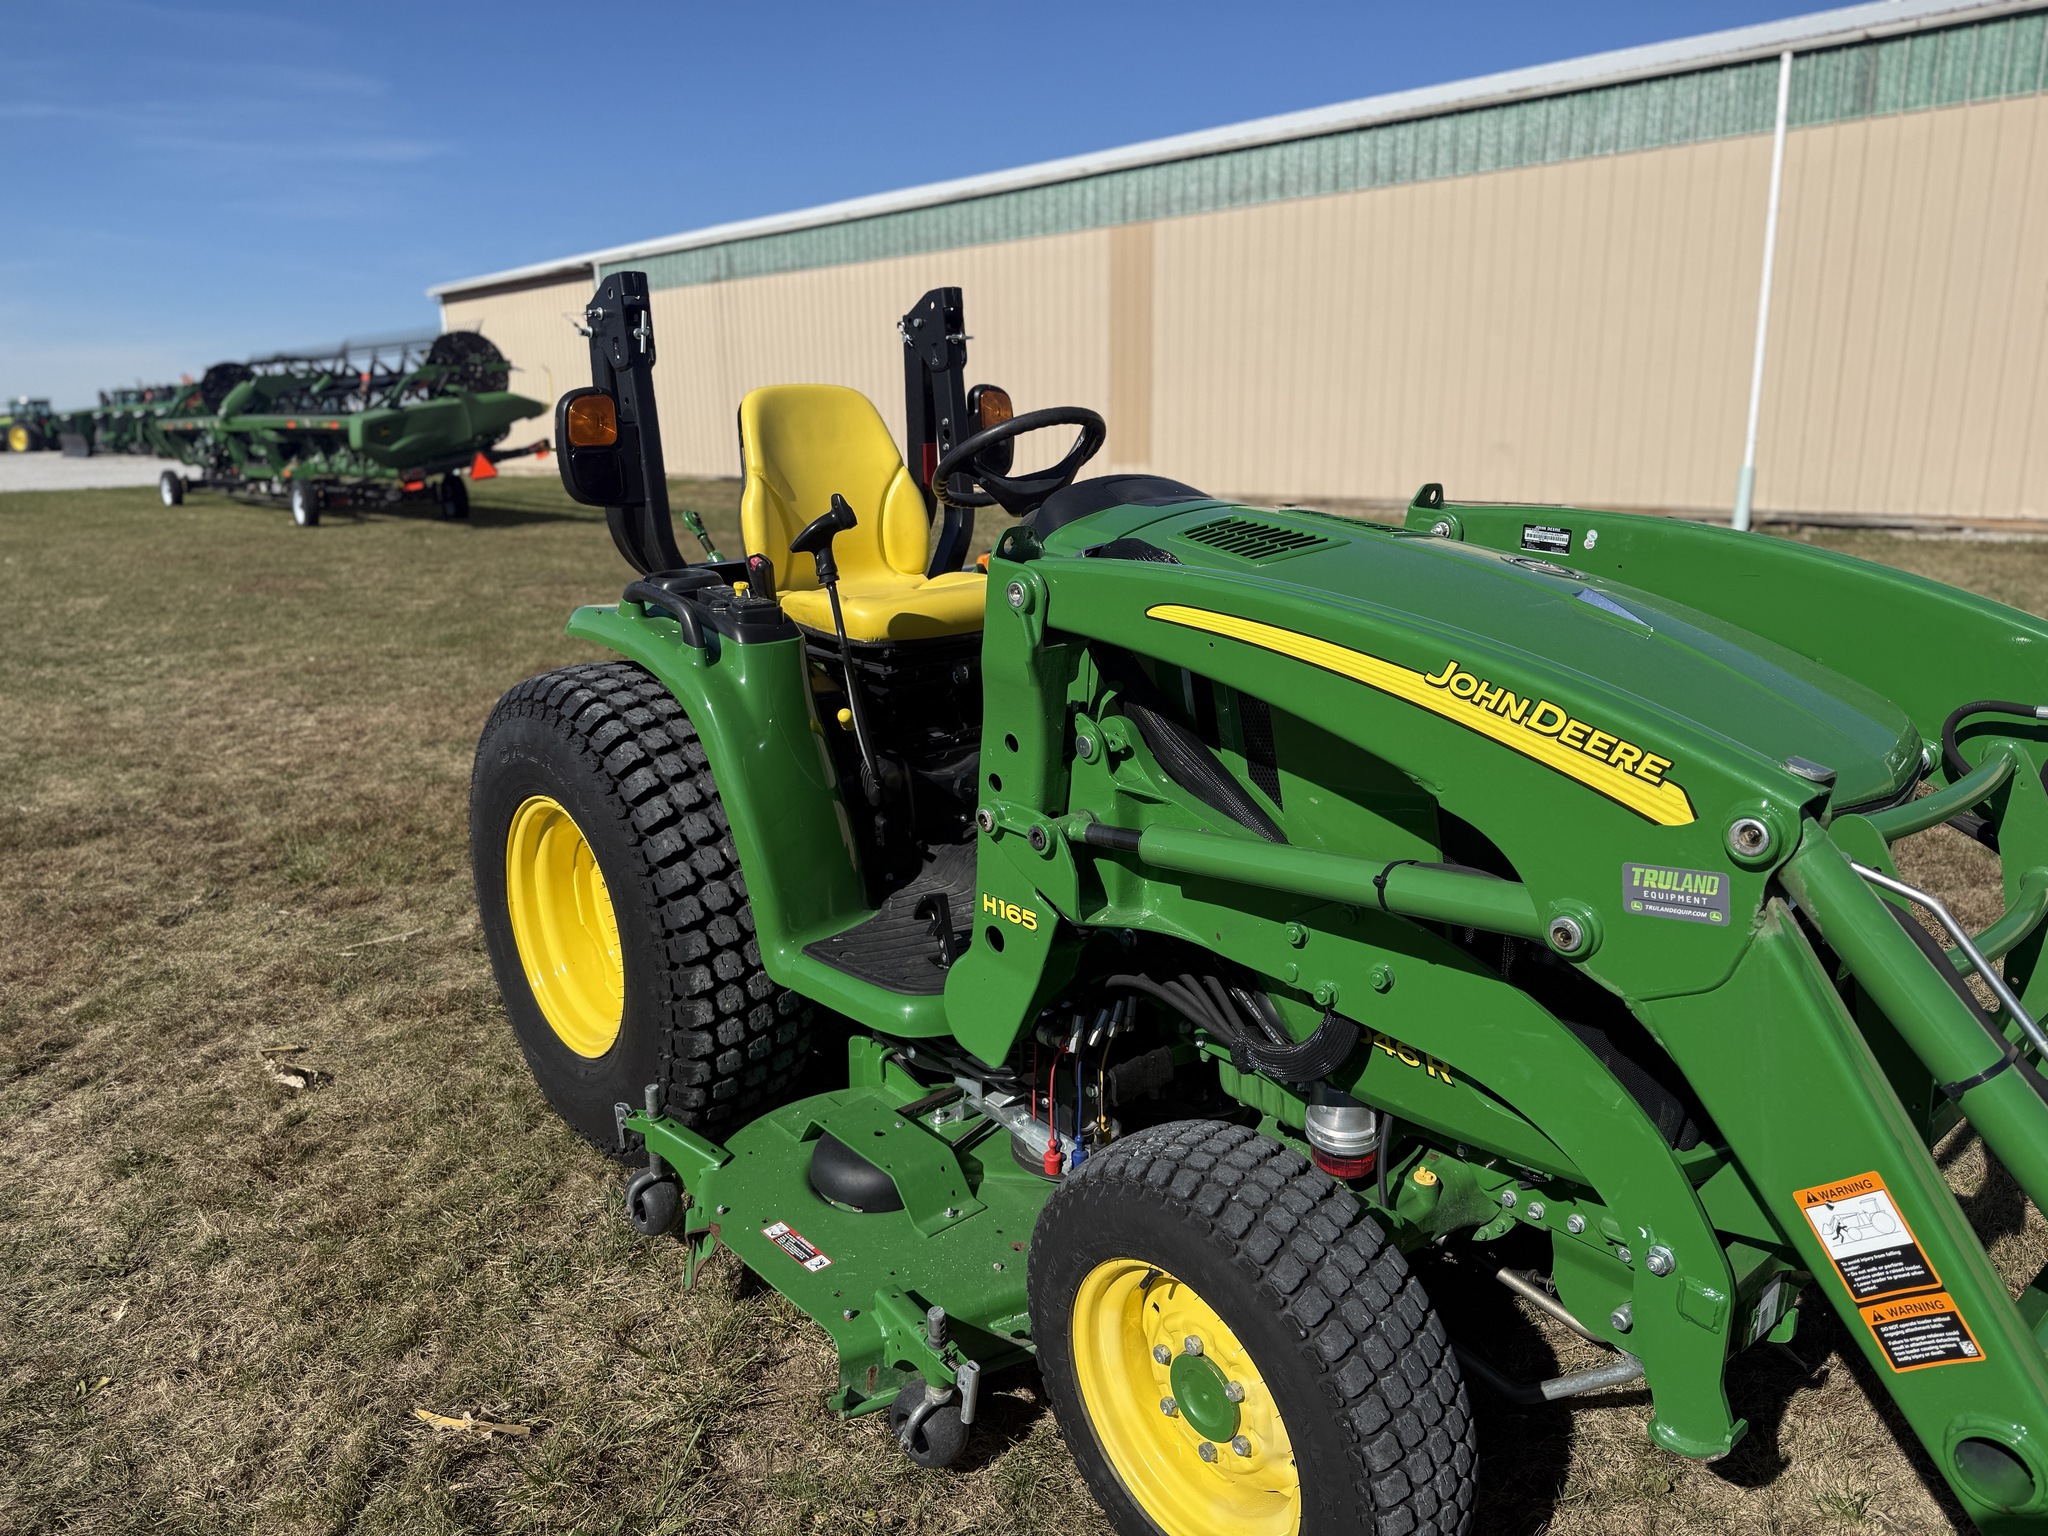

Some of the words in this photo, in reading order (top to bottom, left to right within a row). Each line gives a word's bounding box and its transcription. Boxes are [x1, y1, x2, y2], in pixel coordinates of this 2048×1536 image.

[1425, 660, 1532, 727] JOHN
[1526, 699, 1674, 787] DEERE
[1631, 867, 1720, 897] TRULAND
[1643, 890, 1708, 905] EQUIPMENT
[982, 892, 1039, 932] H165
[1645, 904, 1707, 918] TRULANDEQUIP.COM
[1817, 1179, 1874, 1200] WARNING
[1892, 1272, 1910, 1280] ground
[1886, 1300, 1945, 1318] WARNING
